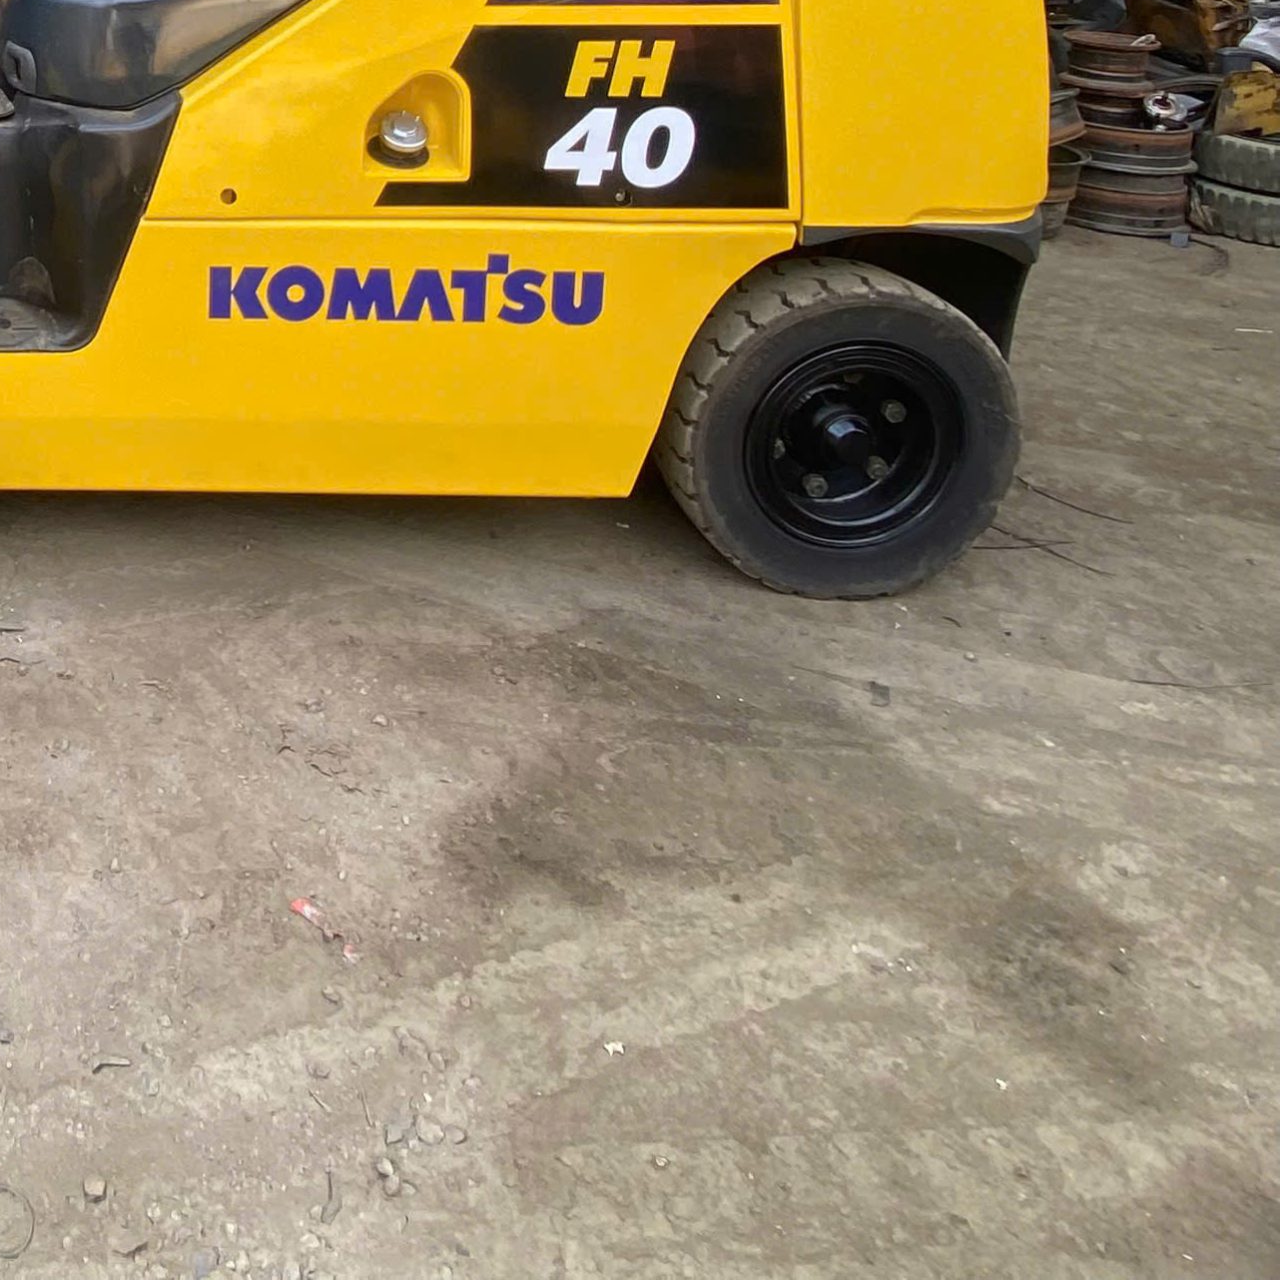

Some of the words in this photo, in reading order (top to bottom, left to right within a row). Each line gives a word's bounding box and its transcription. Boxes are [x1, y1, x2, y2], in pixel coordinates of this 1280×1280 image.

[564, 40, 676, 97] FH
[543, 107, 696, 188] 40
[208, 254, 605, 325] KOMATSU
